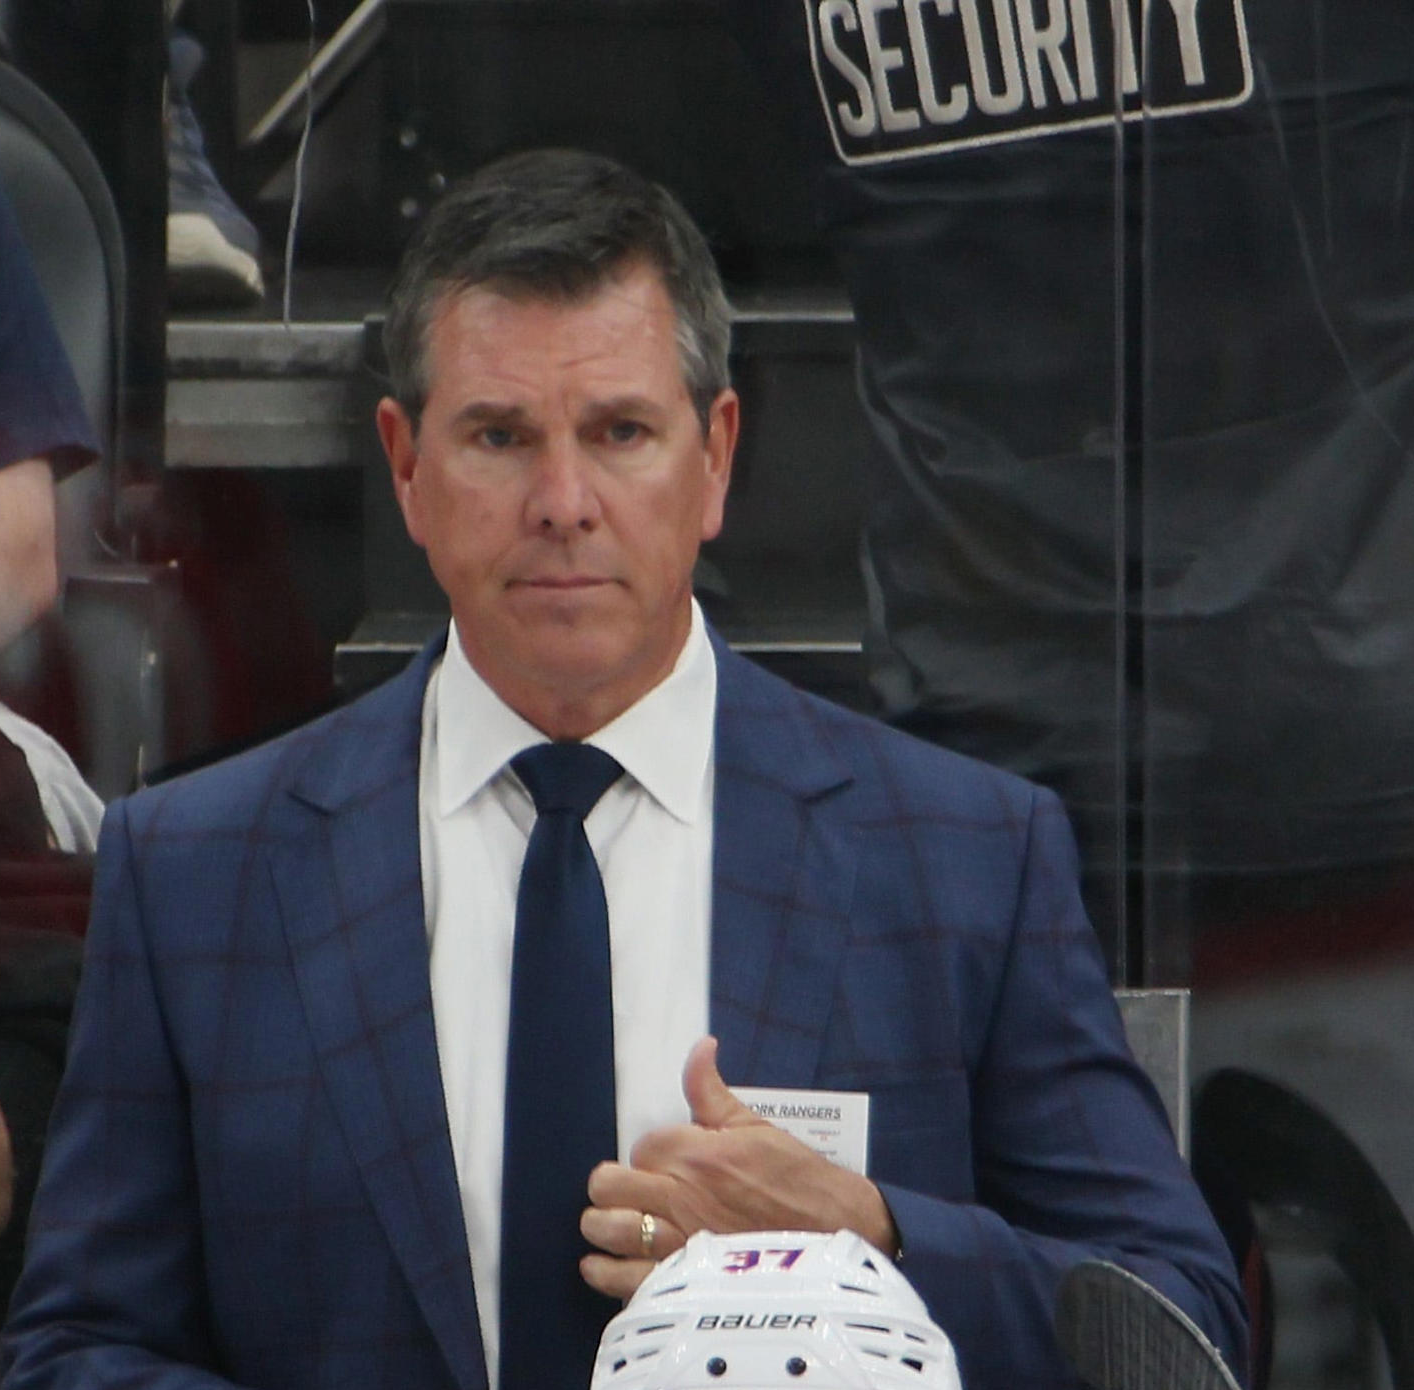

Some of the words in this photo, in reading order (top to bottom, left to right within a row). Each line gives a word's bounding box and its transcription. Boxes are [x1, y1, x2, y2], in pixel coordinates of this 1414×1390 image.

[819, 0, 1205, 137] SECURITY
[748, 1103, 775, 1117] ORK
[779, 1103, 842, 1121] RANGERS
[722, 1248, 804, 1274] 37
[695, 1313, 818, 1331] BAUER
